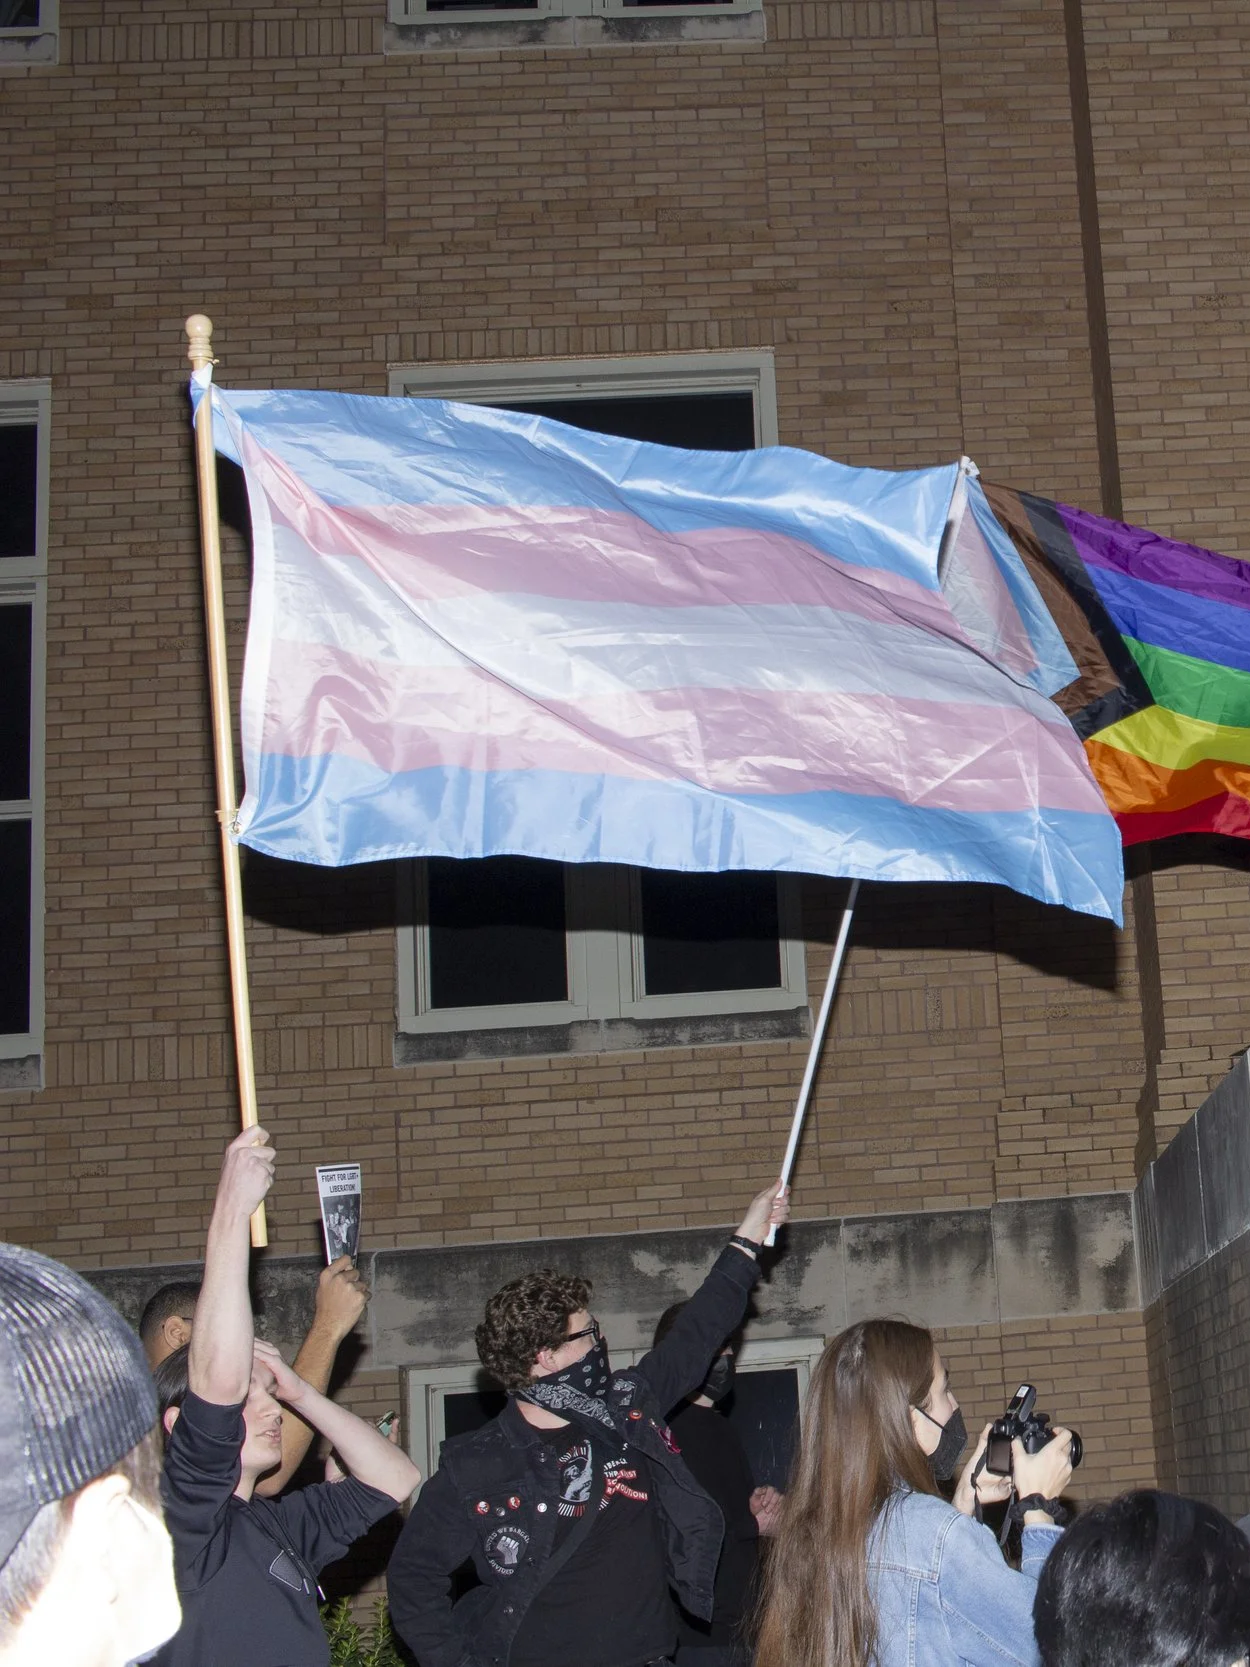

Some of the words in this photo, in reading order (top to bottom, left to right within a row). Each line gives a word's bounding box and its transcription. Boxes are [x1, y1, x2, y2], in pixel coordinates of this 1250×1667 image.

[321, 1174, 336, 1182] FIGHT
[337, 1173, 347, 1181] FOR
[509, 1527, 530, 1544] BARGAI
[489, 1559, 514, 1575] DIVIDED
